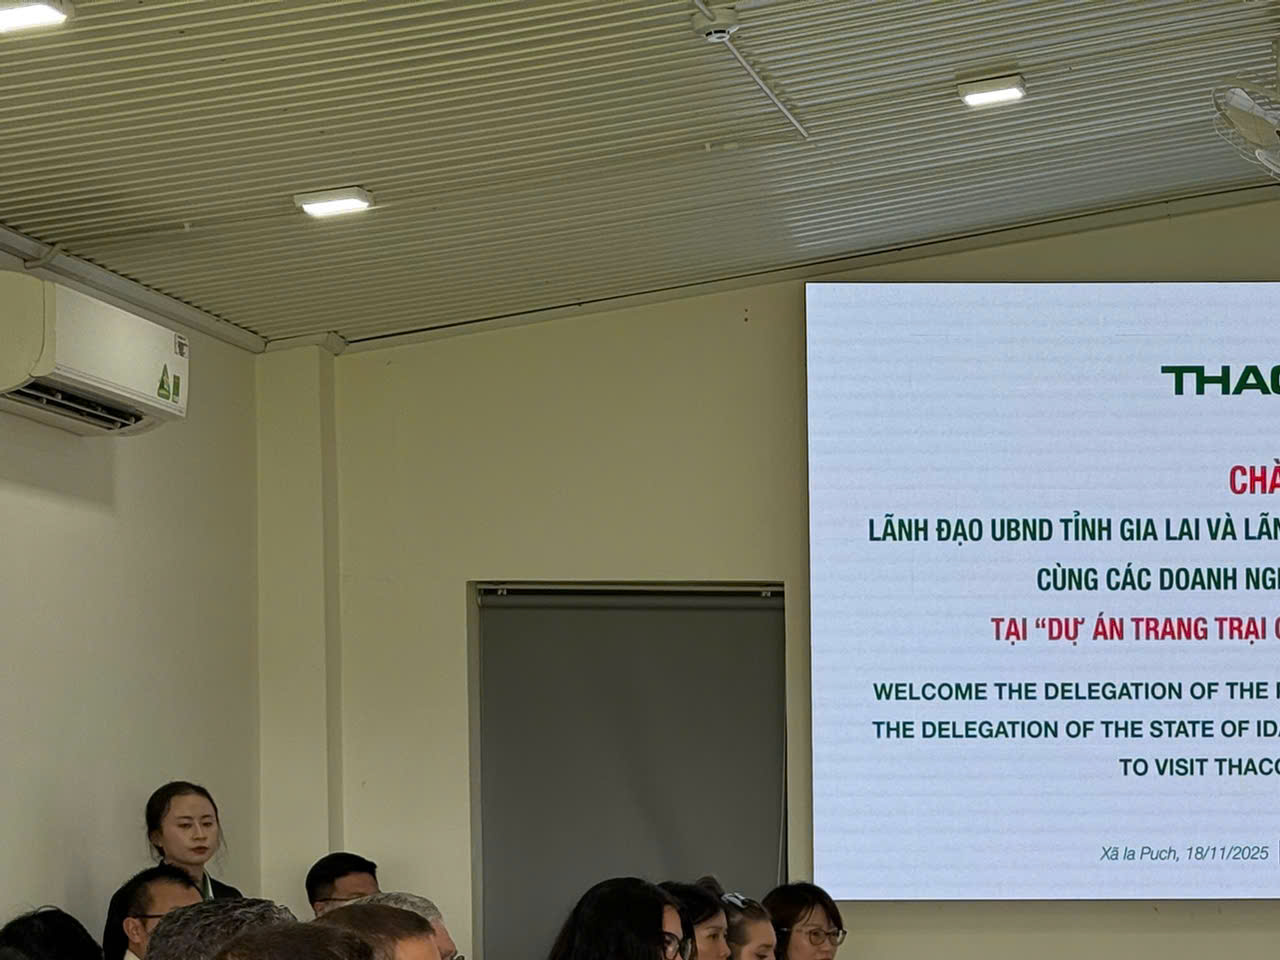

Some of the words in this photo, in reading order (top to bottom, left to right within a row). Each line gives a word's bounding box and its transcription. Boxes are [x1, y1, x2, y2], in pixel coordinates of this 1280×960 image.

[868, 513, 929, 542] LÃNH
[935, 517, 984, 547] ĐẠO
[990, 518, 1054, 542] UBND
[1058, 510, 1112, 542] TỈNH
[1119, 516, 1159, 542] GIA
[1165, 517, 1200, 541] LAI
[1206, 511, 1238, 541] VÀ
[1036, 562, 1099, 592] CÙNG
[1105, 561, 1152, 592] CÁC
[1159, 566, 1238, 591] DOANH
[990, 617, 1028, 646] TẠI
[1092, 611, 1124, 641] ÁN
[1130, 616, 1208, 641] TRANG
[1214, 616, 1267, 645] TRẠI
[872, 682, 988, 702] WELCOME
[993, 682, 1038, 701] THE
[1044, 681, 1183, 701] DELEGATION
[1189, 681, 1220, 701] OF
[1224, 681, 1269, 700] THE
[871, 720, 915, 739] THE
[921, 719, 1059, 739] DELEGATION
[1065, 720, 1095, 739] OF
[1100, 720, 1144, 740] THE
[1149, 719, 1215, 739] STATE
[1220, 719, 1250, 738] OF
[1118, 757, 1149, 777] TO
[1154, 757, 1209, 777] VISIT
[1139, 846, 1180, 863] Puch,
[1186, 845, 1270, 862] 18/11/2025
